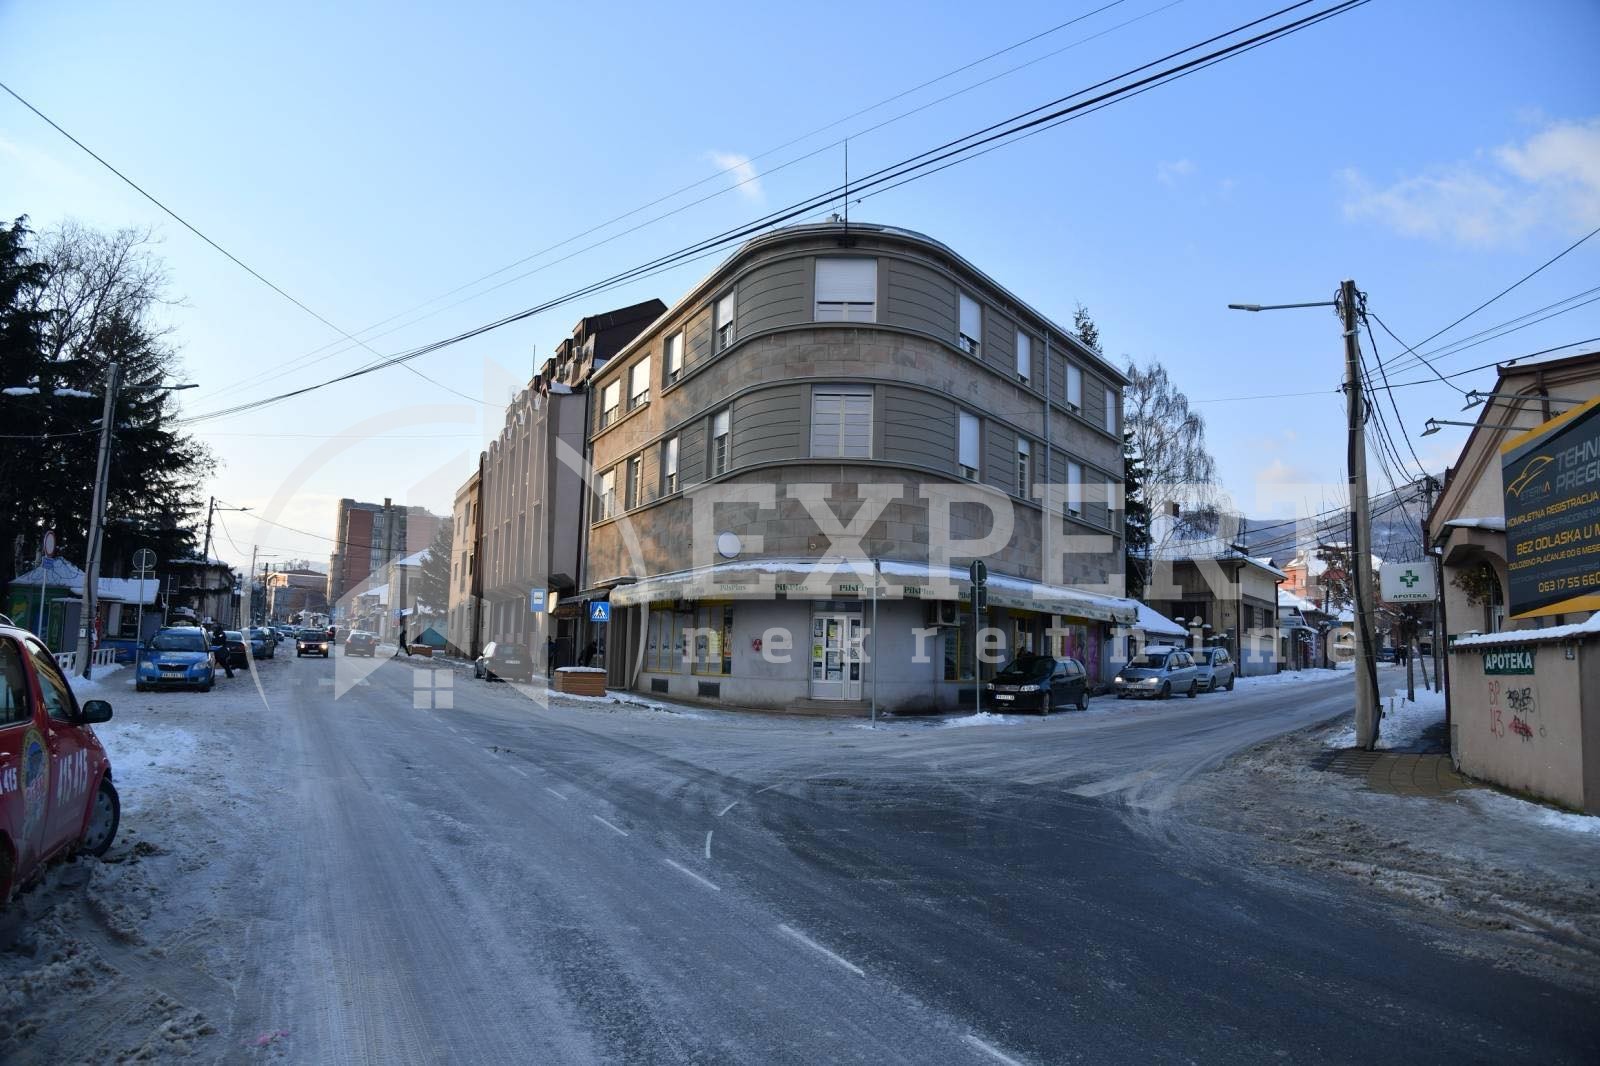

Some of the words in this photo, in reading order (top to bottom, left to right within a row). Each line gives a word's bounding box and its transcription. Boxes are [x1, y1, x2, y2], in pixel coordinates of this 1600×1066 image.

[1516, 541, 1534, 555] BEZ
[1535, 528, 1582, 551] ODLASKA
[1583, 524, 1592, 539] U
[1538, 580, 1555, 593] 063
[1567, 576, 1580, 589] 55
[1485, 652, 1533, 670] APOTEKA
